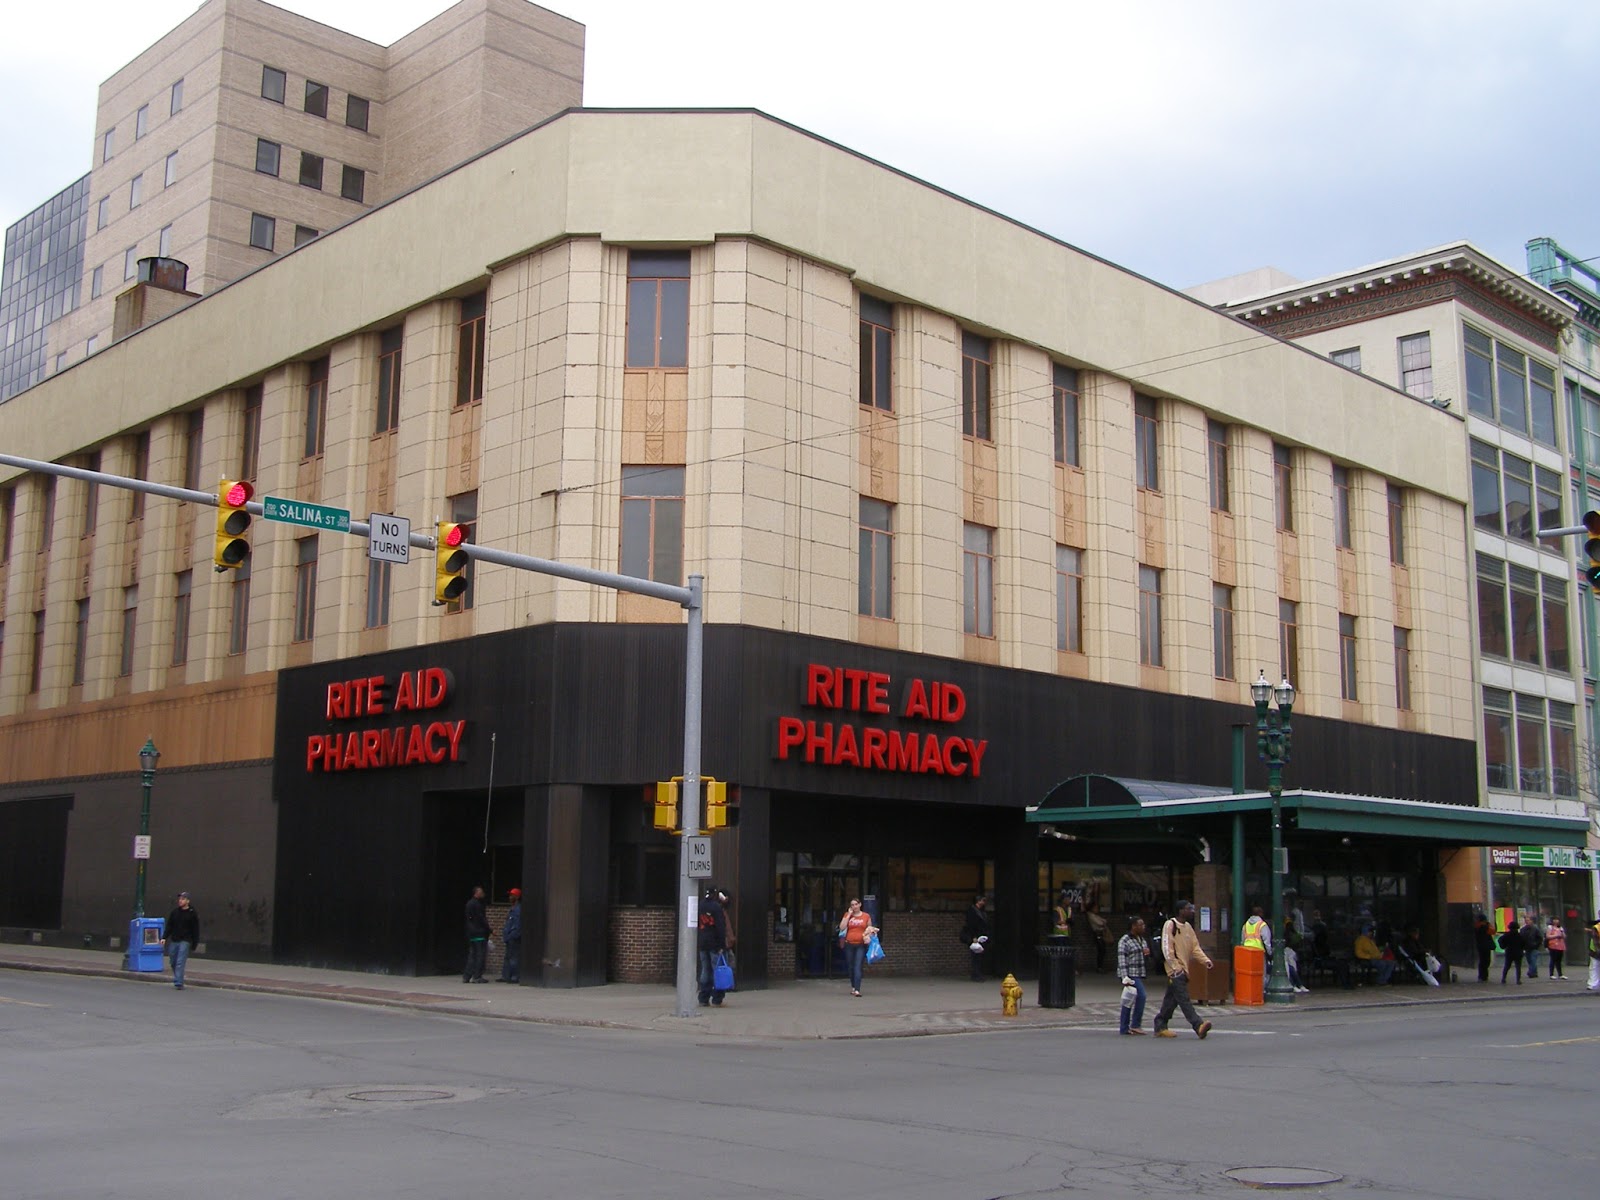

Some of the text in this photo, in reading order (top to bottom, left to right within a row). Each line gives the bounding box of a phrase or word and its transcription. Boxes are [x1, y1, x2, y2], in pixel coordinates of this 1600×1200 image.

[279, 503, 335, 525] SALINA ST
[381, 522, 399, 537] NO
[372, 540, 407, 556] TURNS
[326, 667, 448, 719] RITE AID
[808, 664, 966, 722] RITE AID
[306, 720, 466, 773] PHARMACY
[778, 717, 987, 777] PHARMACY
[694, 843, 706, 855] NO
[1492, 849, 1518, 857] Dollar
[1549, 848, 1571, 867] Dollar
[690, 861, 711, 871] TURNS
[1494, 856, 1515, 864] Wise
